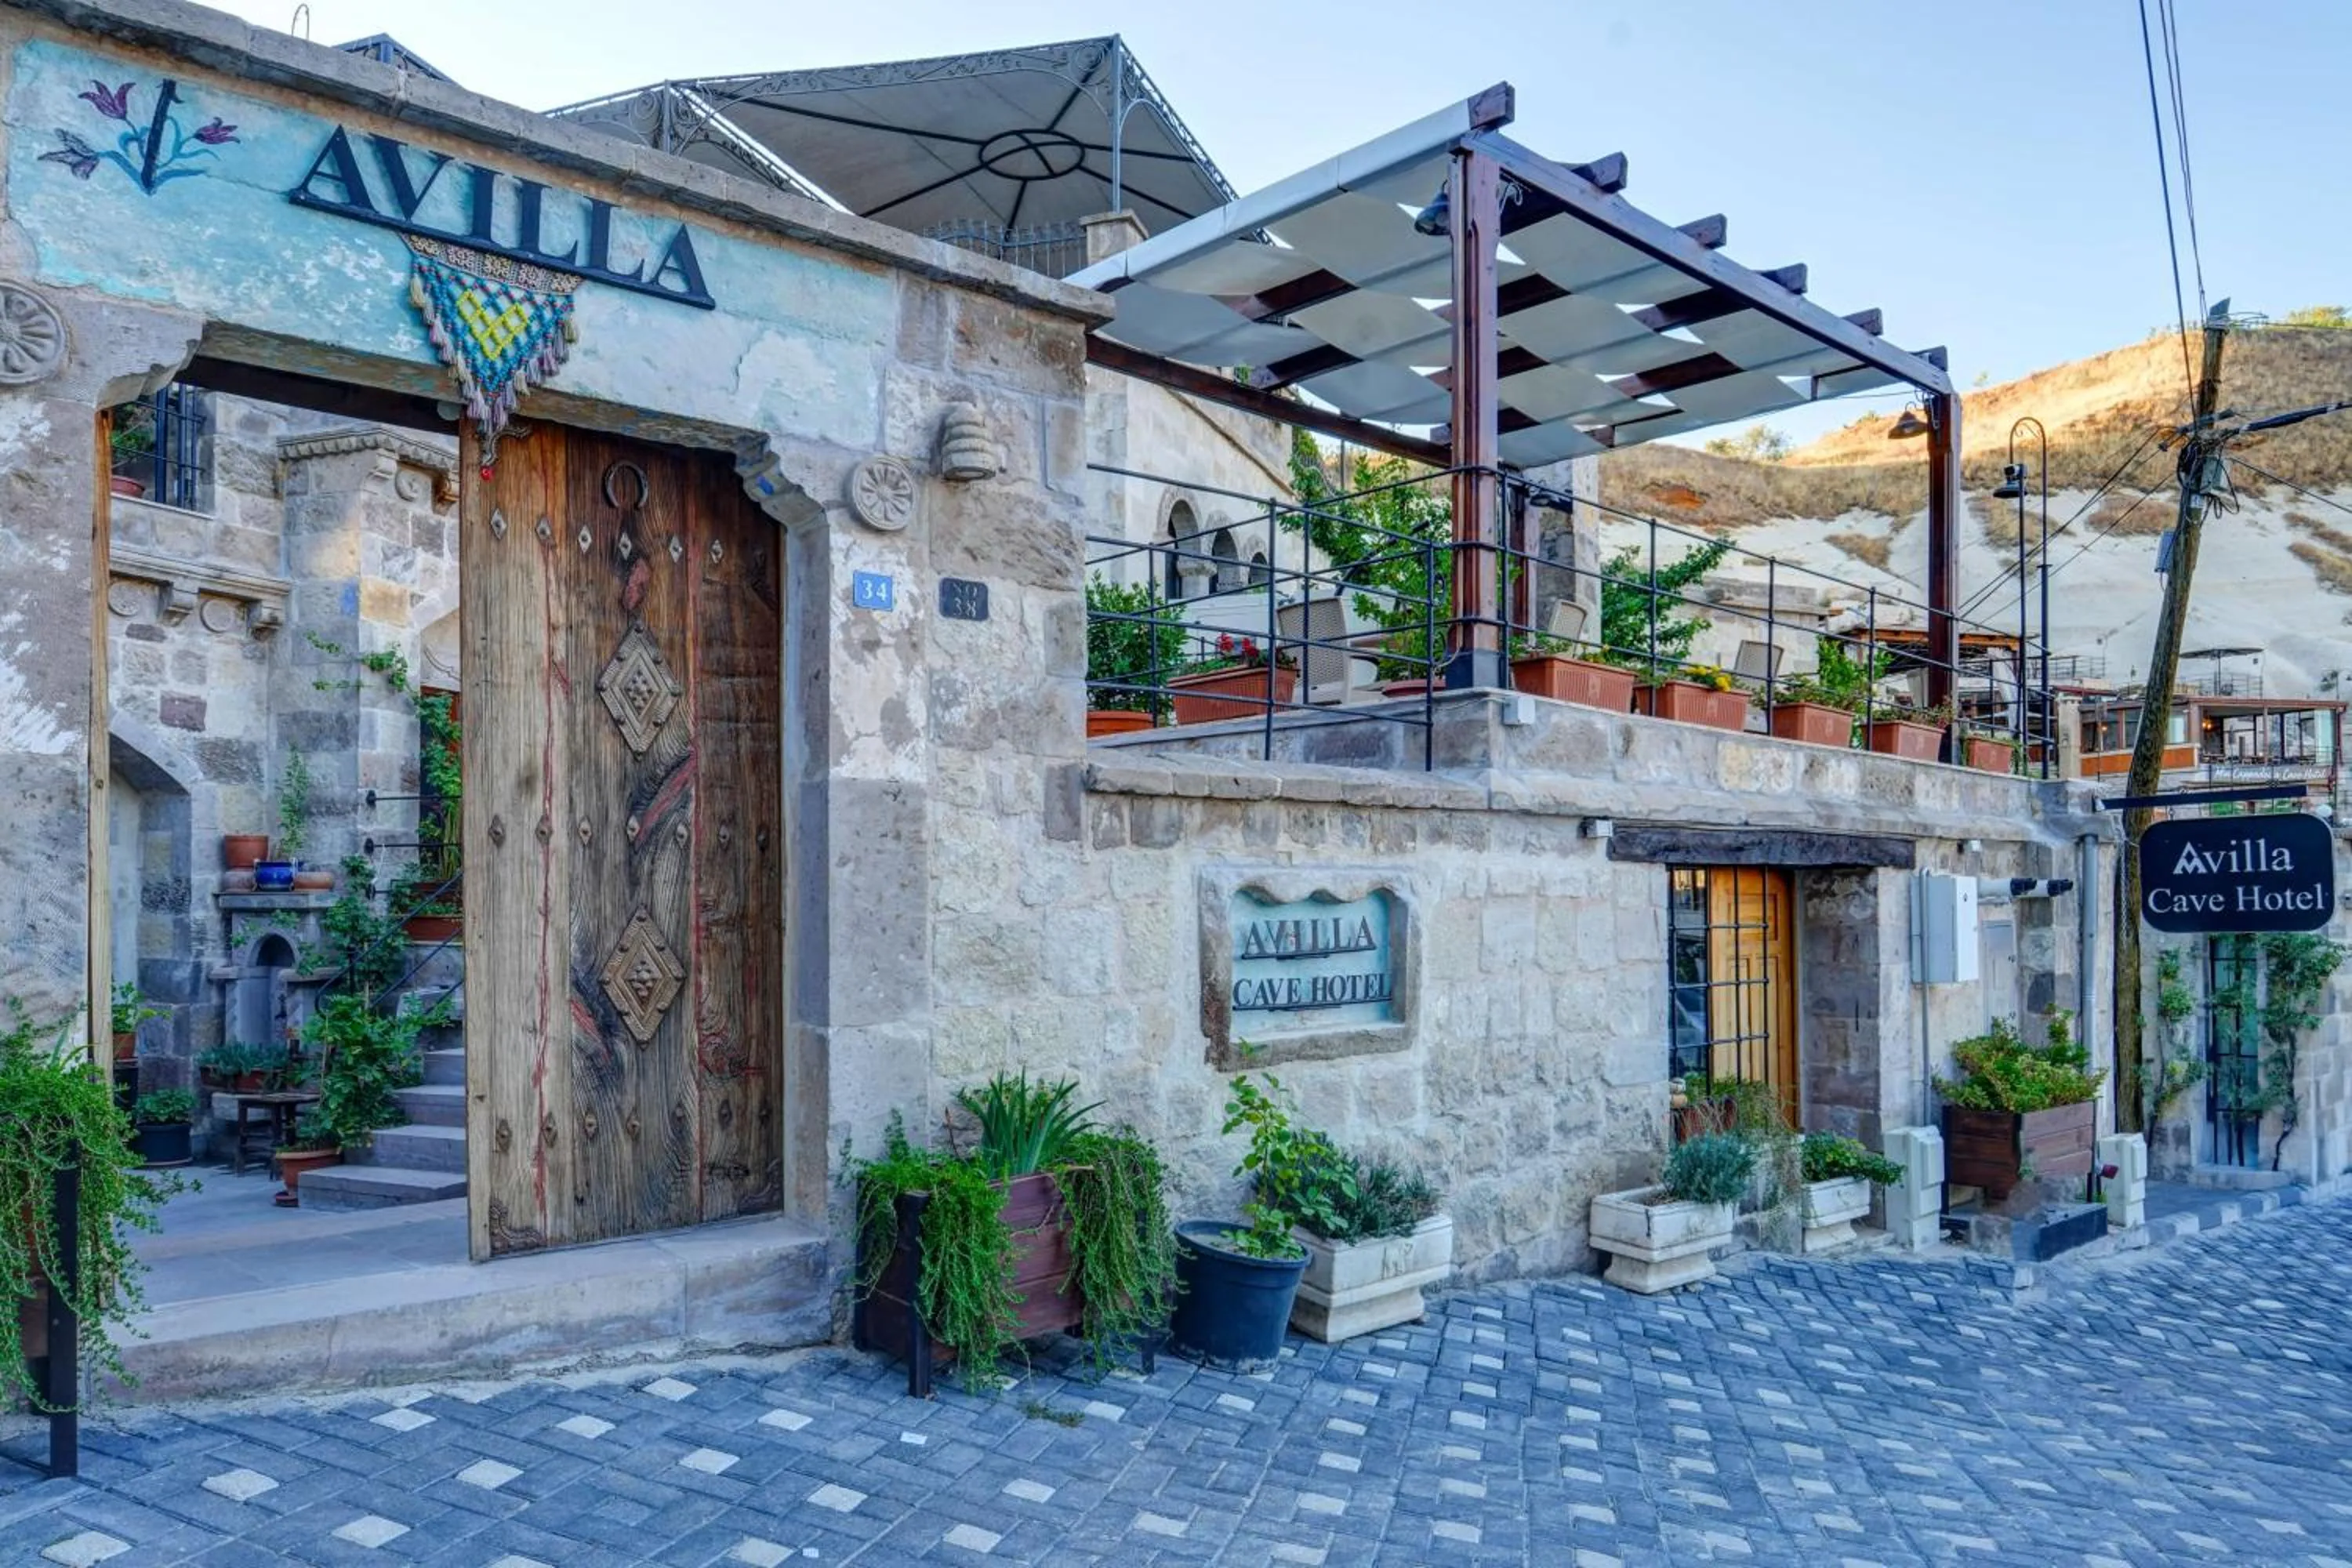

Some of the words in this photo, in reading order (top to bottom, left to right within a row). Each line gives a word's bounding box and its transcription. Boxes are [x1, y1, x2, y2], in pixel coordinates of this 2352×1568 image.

[289, 124, 714, 309] AVILLA
[862, 579, 887, 602] 34
[953, 597, 977, 618] 38
[2172, 838, 2295, 874] Avilla
[2147, 887, 2225, 913] Cave
[2236, 883, 2325, 912] Hotel
[1241, 915, 1377, 958] AVILLA
[1232, 978, 1302, 1009] CAVE
[1311, 972, 1392, 1004] HOTEL
